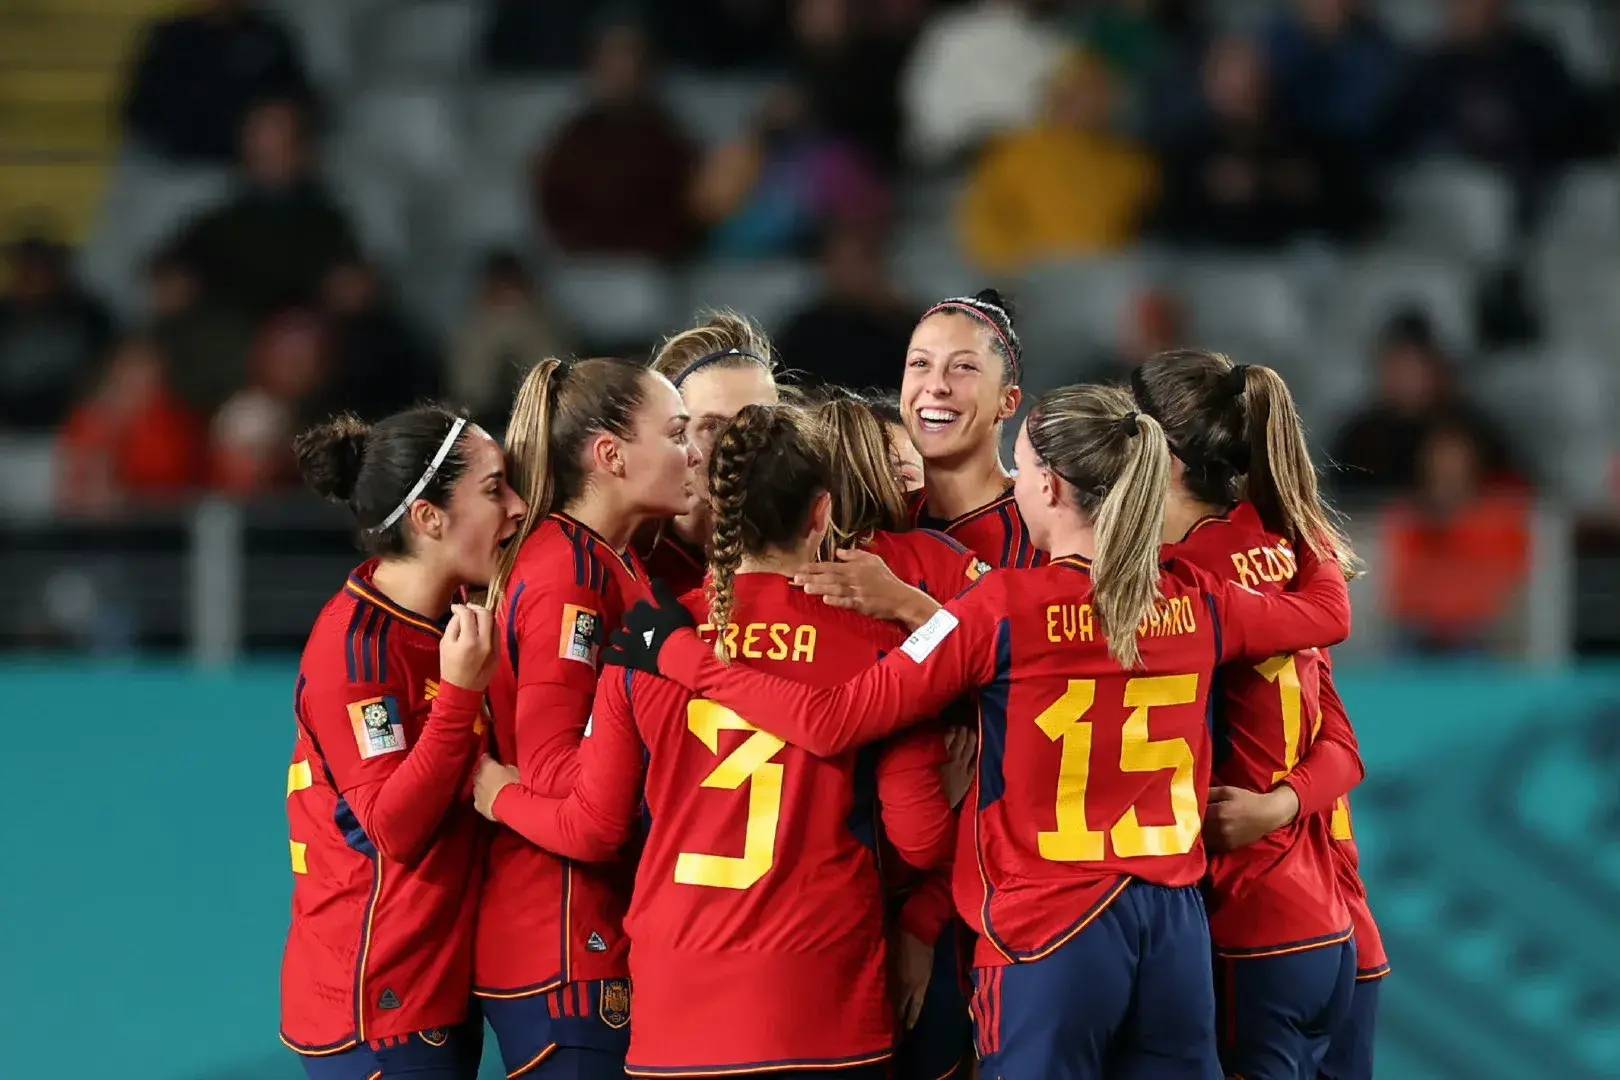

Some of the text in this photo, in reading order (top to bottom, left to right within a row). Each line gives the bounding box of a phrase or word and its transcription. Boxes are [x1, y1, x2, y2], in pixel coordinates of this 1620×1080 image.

[1046, 603, 1094, 643] EVA
[673, 698, 787, 890] 3
[1034, 672, 1202, 862] 15
